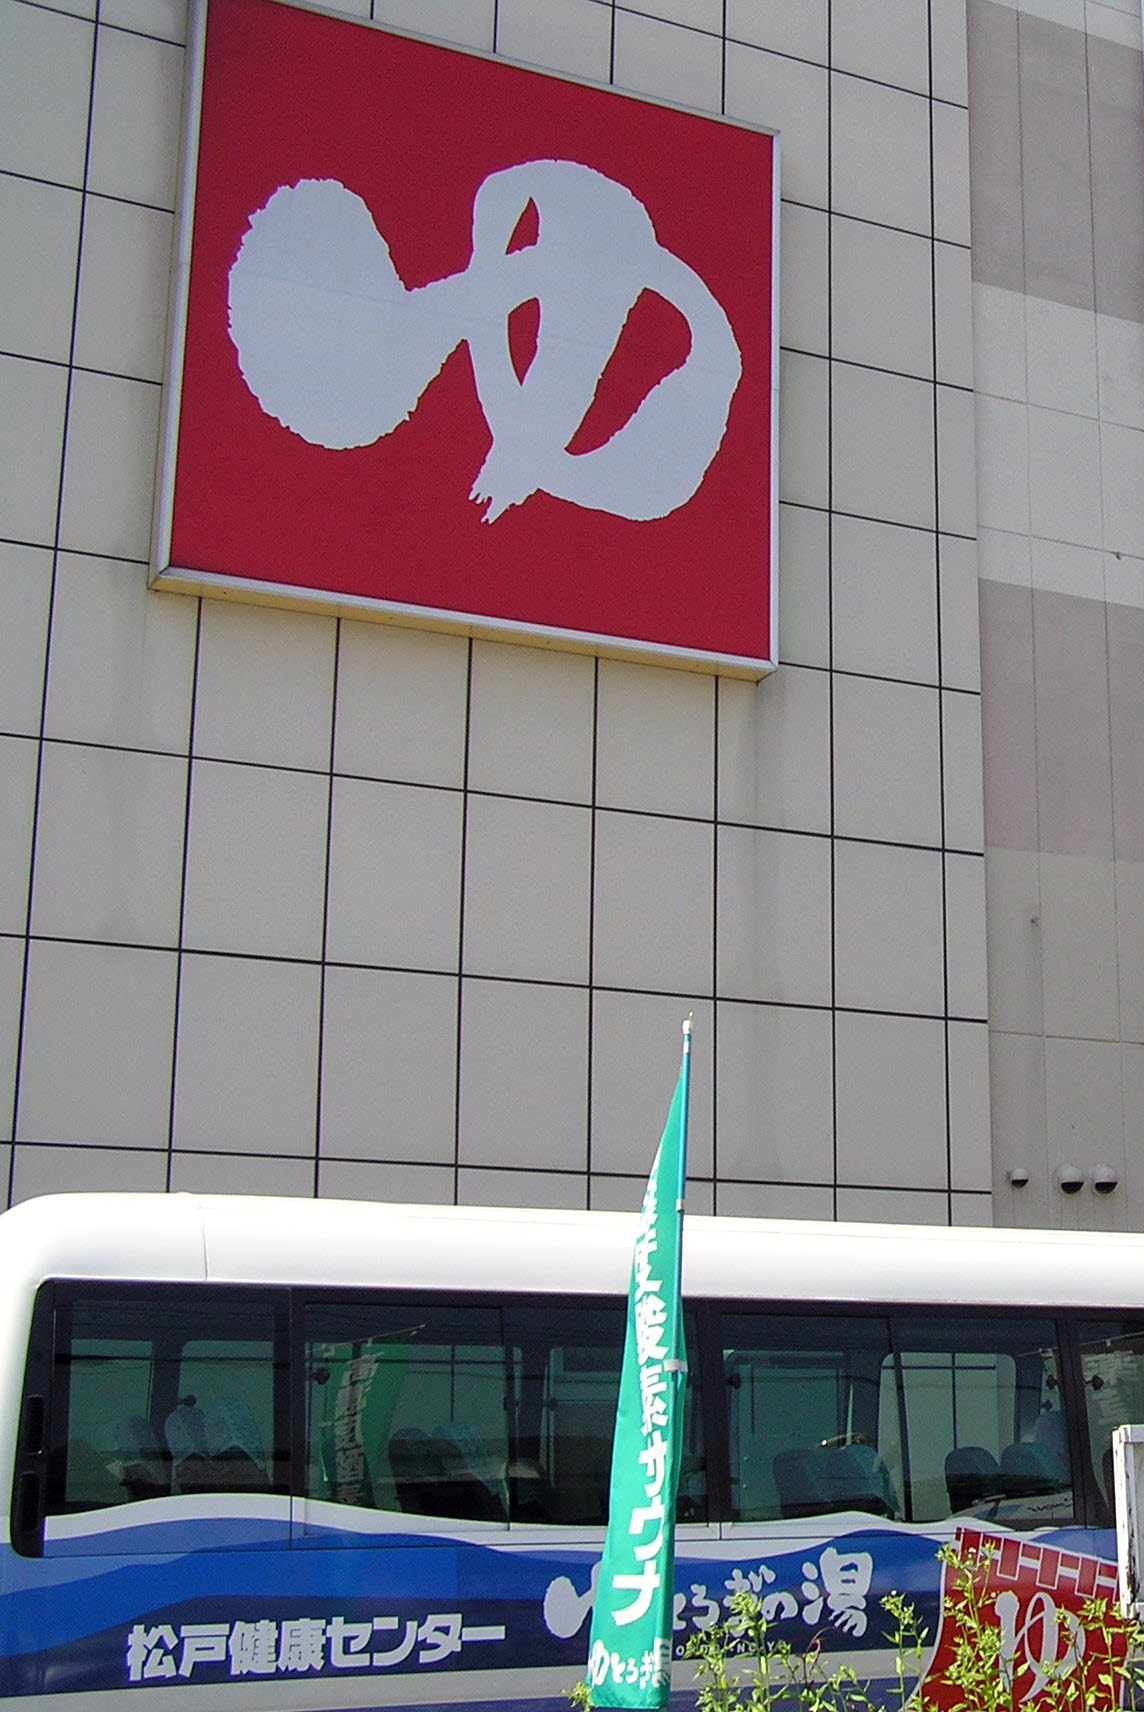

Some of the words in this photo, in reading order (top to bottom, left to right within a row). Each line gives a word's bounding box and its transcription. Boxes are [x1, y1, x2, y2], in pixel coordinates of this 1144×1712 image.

[227, 158, 743, 525] ゆ
[127, 1613, 506, 1681] 松戸健康センター
